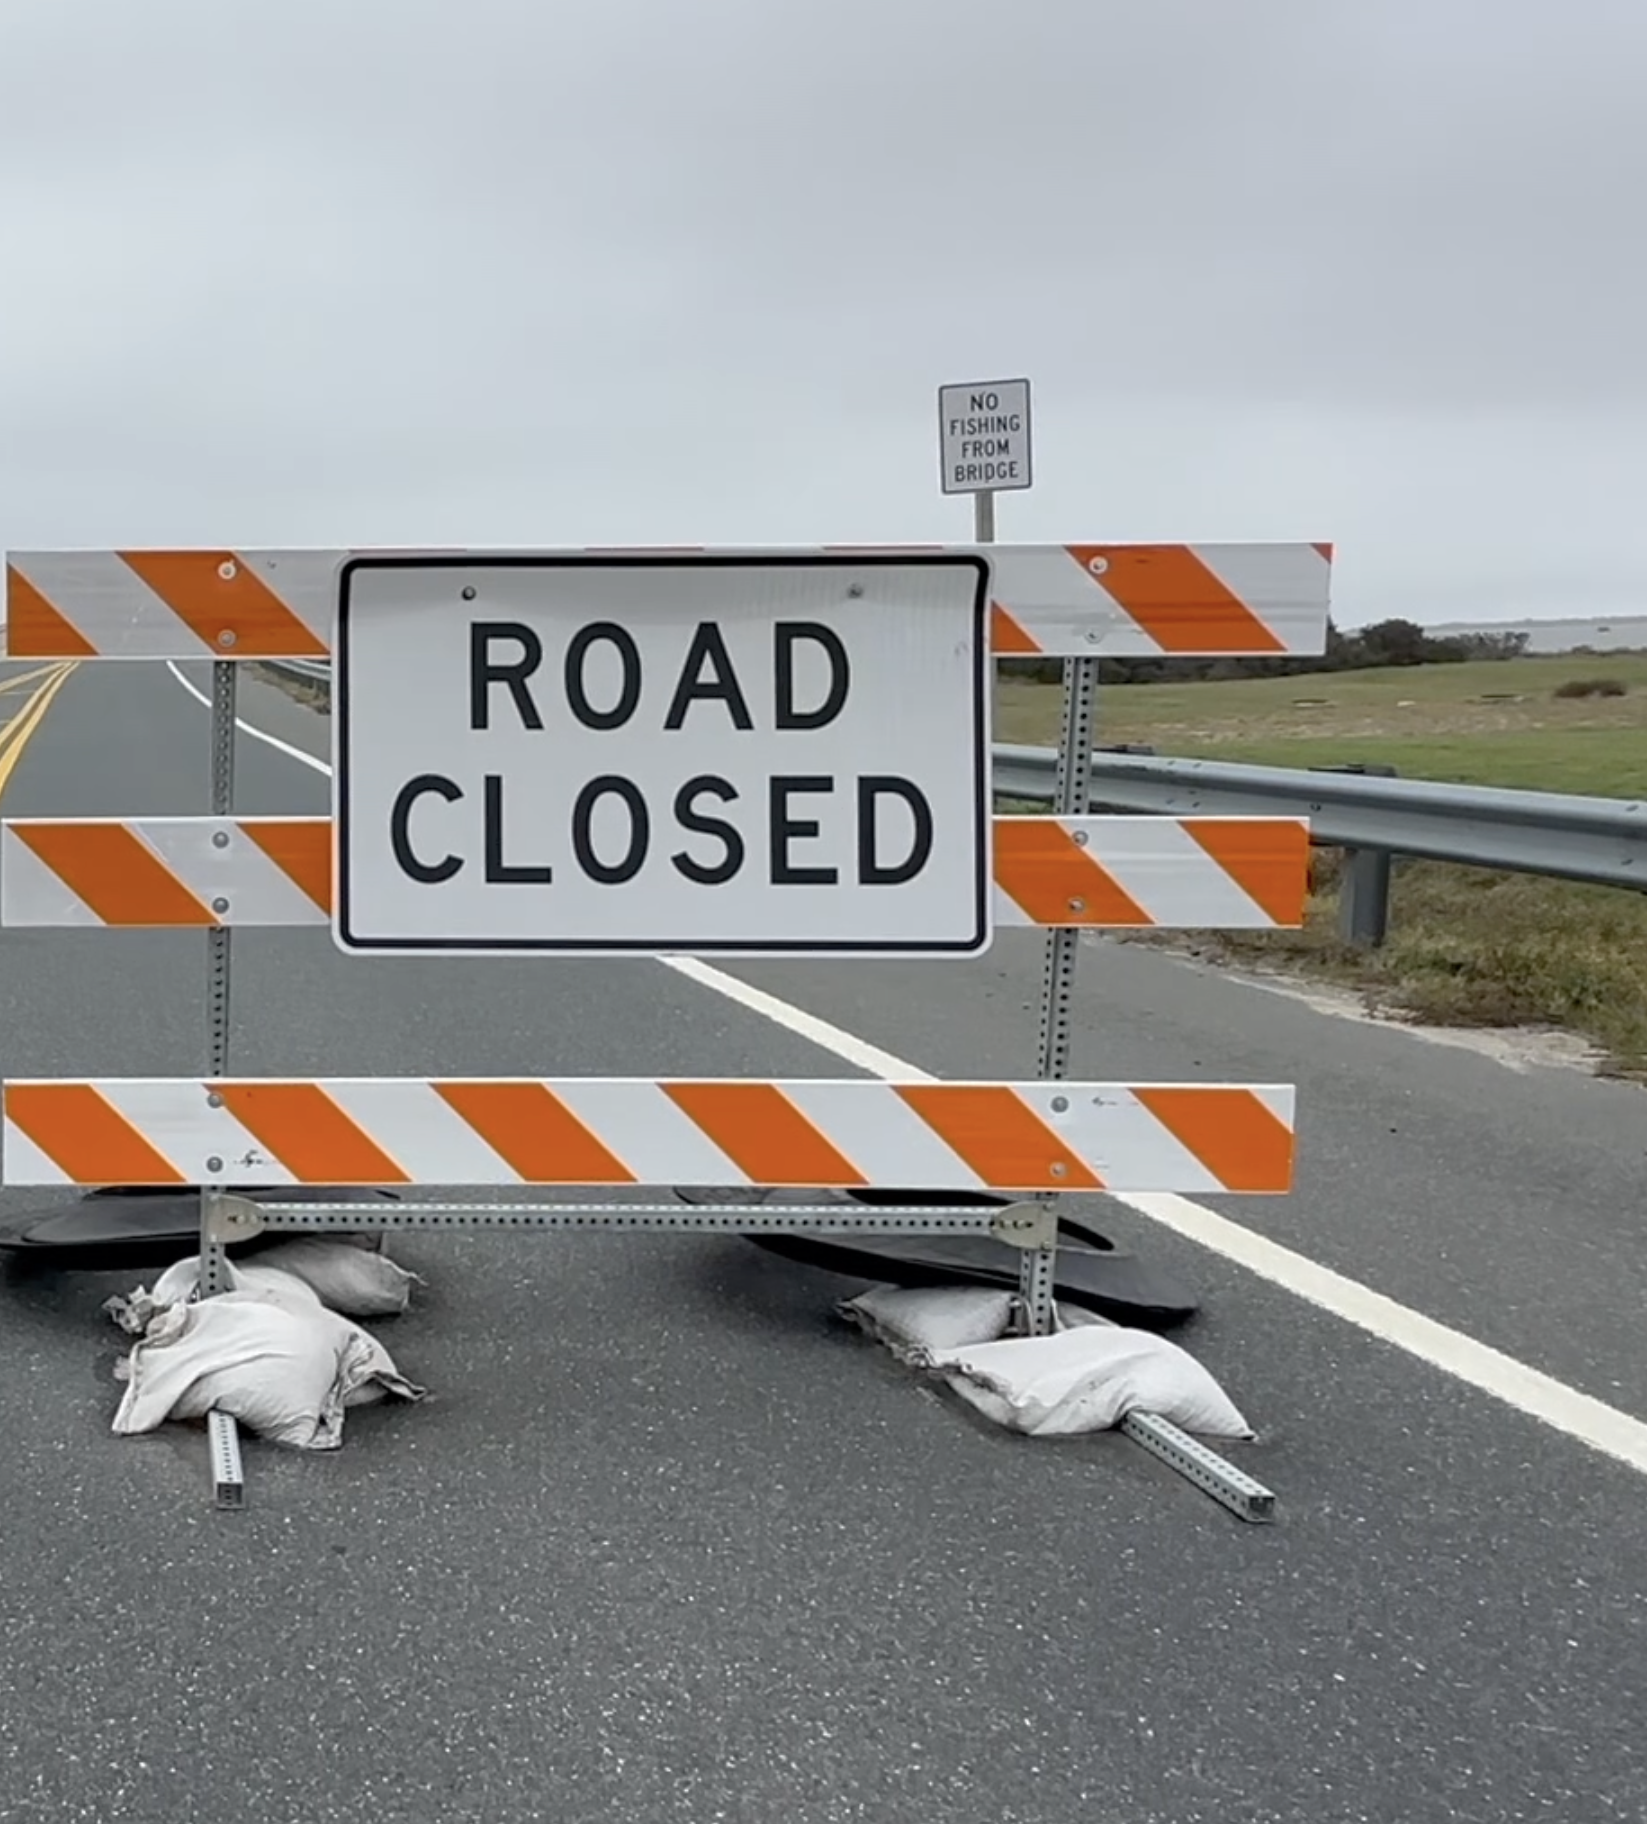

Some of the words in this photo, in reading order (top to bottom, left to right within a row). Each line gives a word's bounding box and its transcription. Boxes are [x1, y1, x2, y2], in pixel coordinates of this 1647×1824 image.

[969, 393, 999, 412] NO
[949, 414, 1020, 436] FISHING
[961, 439, 1009, 458] FROM
[955, 461, 1019, 482] BRIDGE
[470, 621, 850, 731] ROAD
[390, 774, 934, 886] CLOSED
